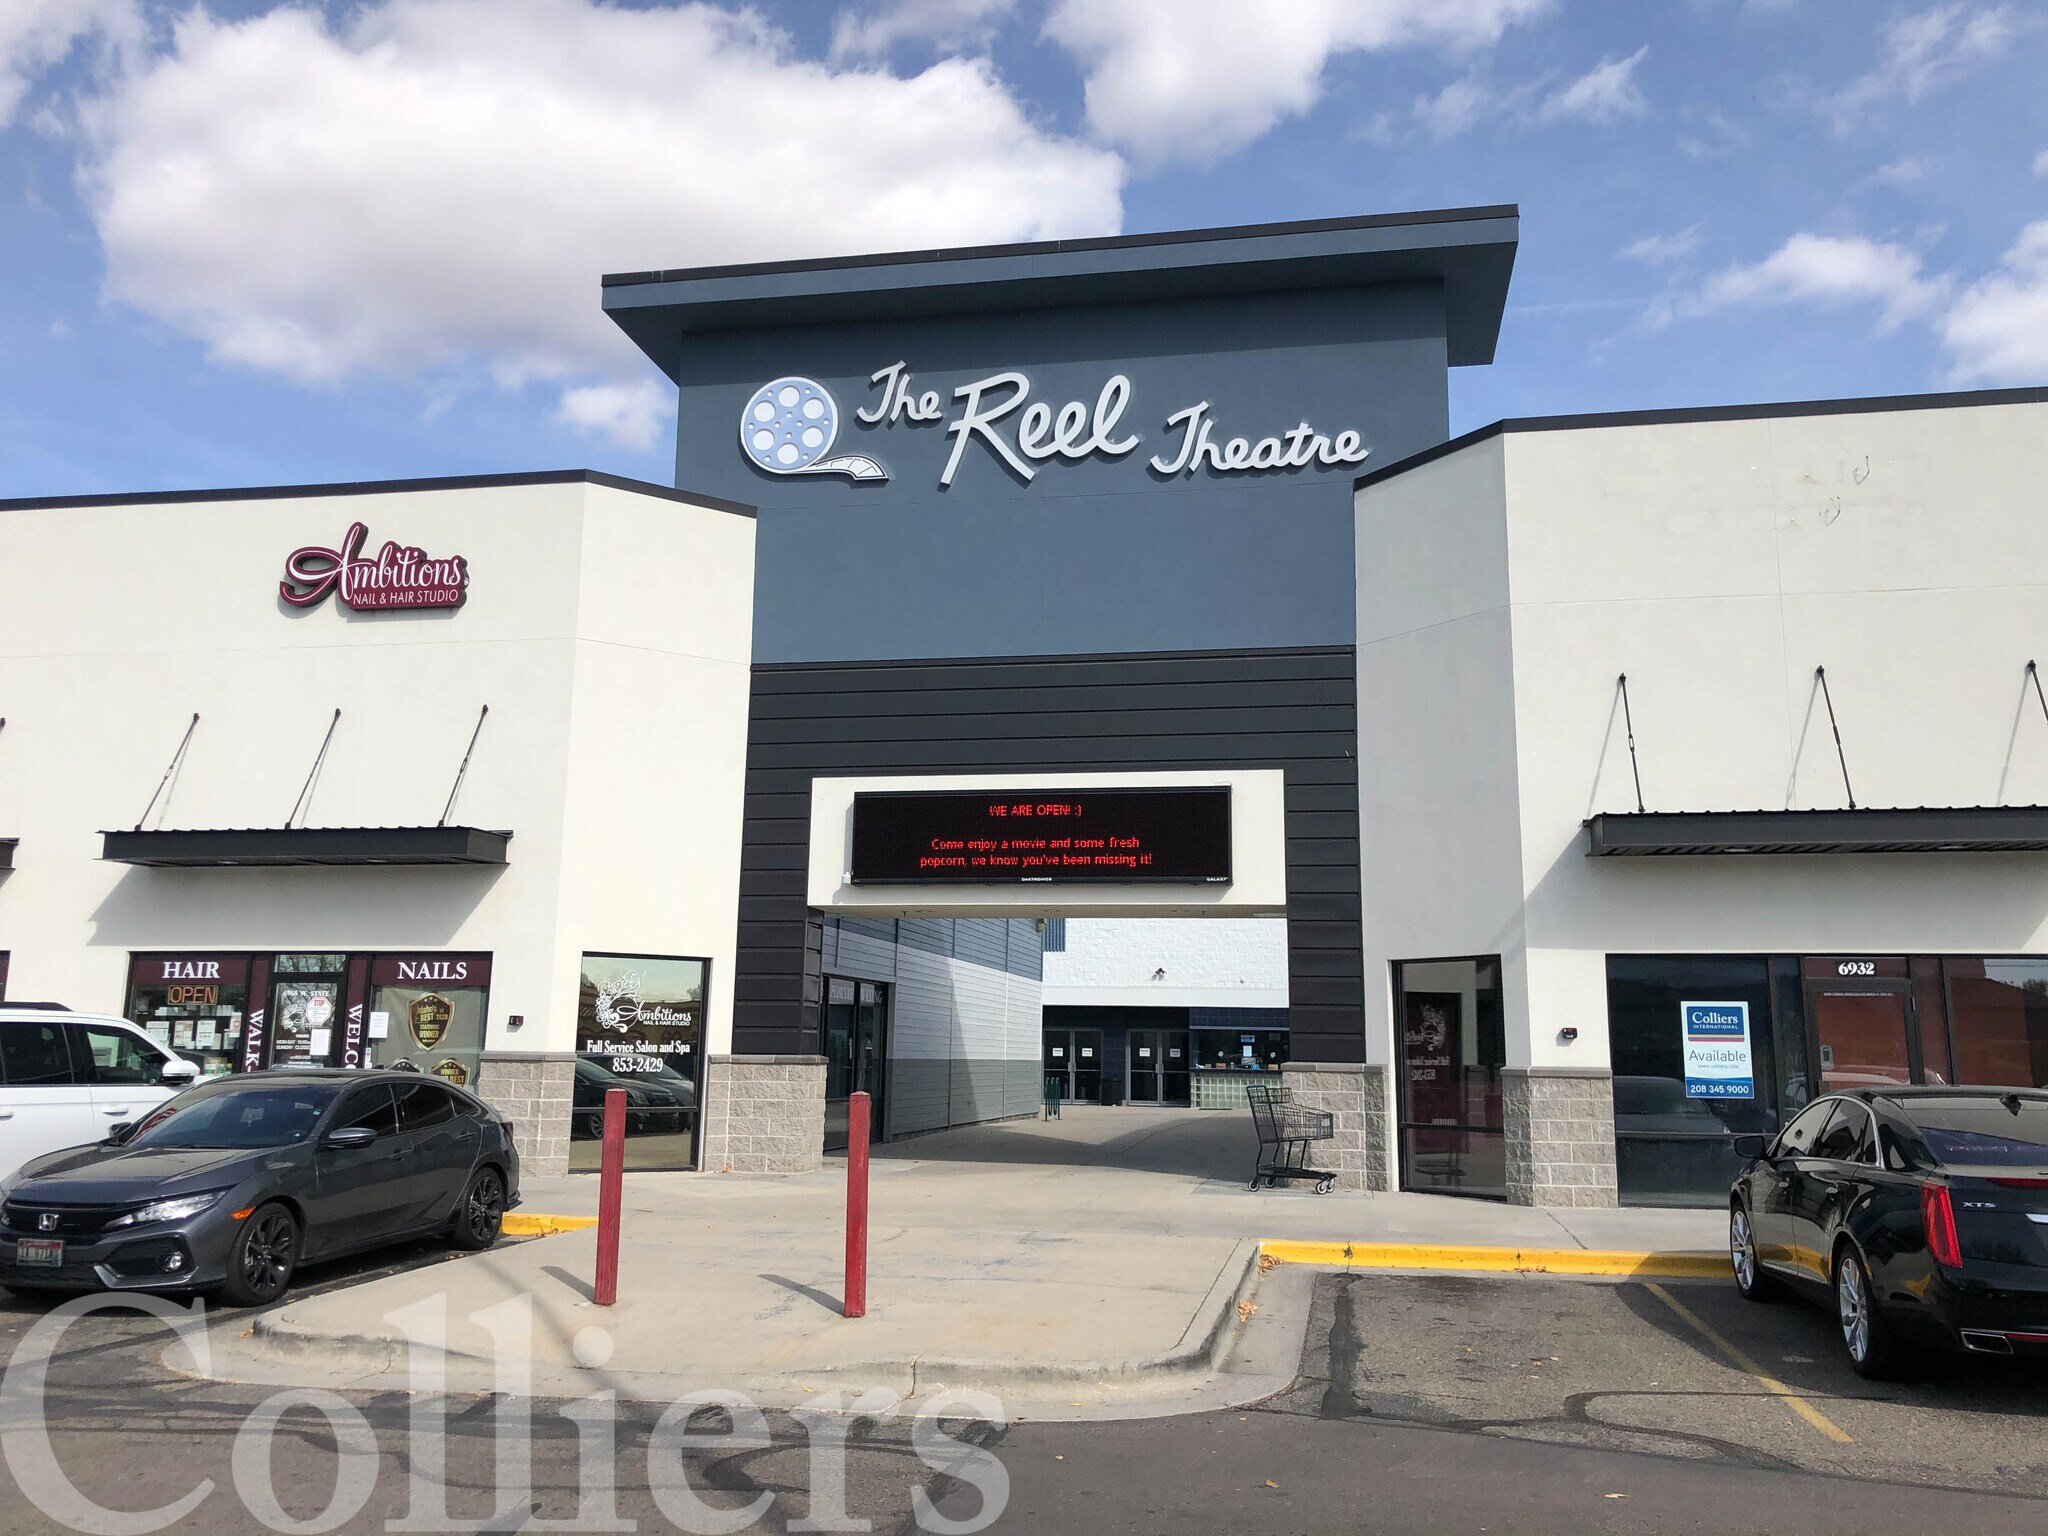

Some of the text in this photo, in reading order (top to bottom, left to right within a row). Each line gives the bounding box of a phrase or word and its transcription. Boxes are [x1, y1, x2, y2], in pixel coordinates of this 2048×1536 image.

[857, 360, 1369, 484] The Reel Theatre
[282, 525, 461, 600] Ambitions
[353, 590, 459, 605] NAIL & HAIR STUDIO
[989, 805, 1007, 816] WE
[1011, 805, 1032, 816] ARE
[1036, 804, 1071, 816] OPEN!
[931, 837, 1140, 851] Come enjoy a movie and some fresh
[920, 853, 1152, 868] popcorn, we know you've been missing it!
[161, 961, 220, 979] HAIR
[397, 961, 467, 980] NAILS
[1838, 961, 1875, 976] 6932
[170, 986, 216, 1003] OPEN
[420, 1013, 434, 1022] BEST
[616, 1000, 692, 1022] Ambitions
[1692, 1012, 1739, 1024] Colliers
[419, 1031, 439, 1039] WINNER
[587, 1040, 691, 1055] Full Service Salon and Spa
[1689, 1050, 1747, 1062] Available
[441, 1068, 459, 1076] WINNER
[612, 1057, 664, 1073] 853-2429
[1690, 1085, 1749, 1094] 208 345 9000
[1963, 1201, 1996, 1209] XTS
